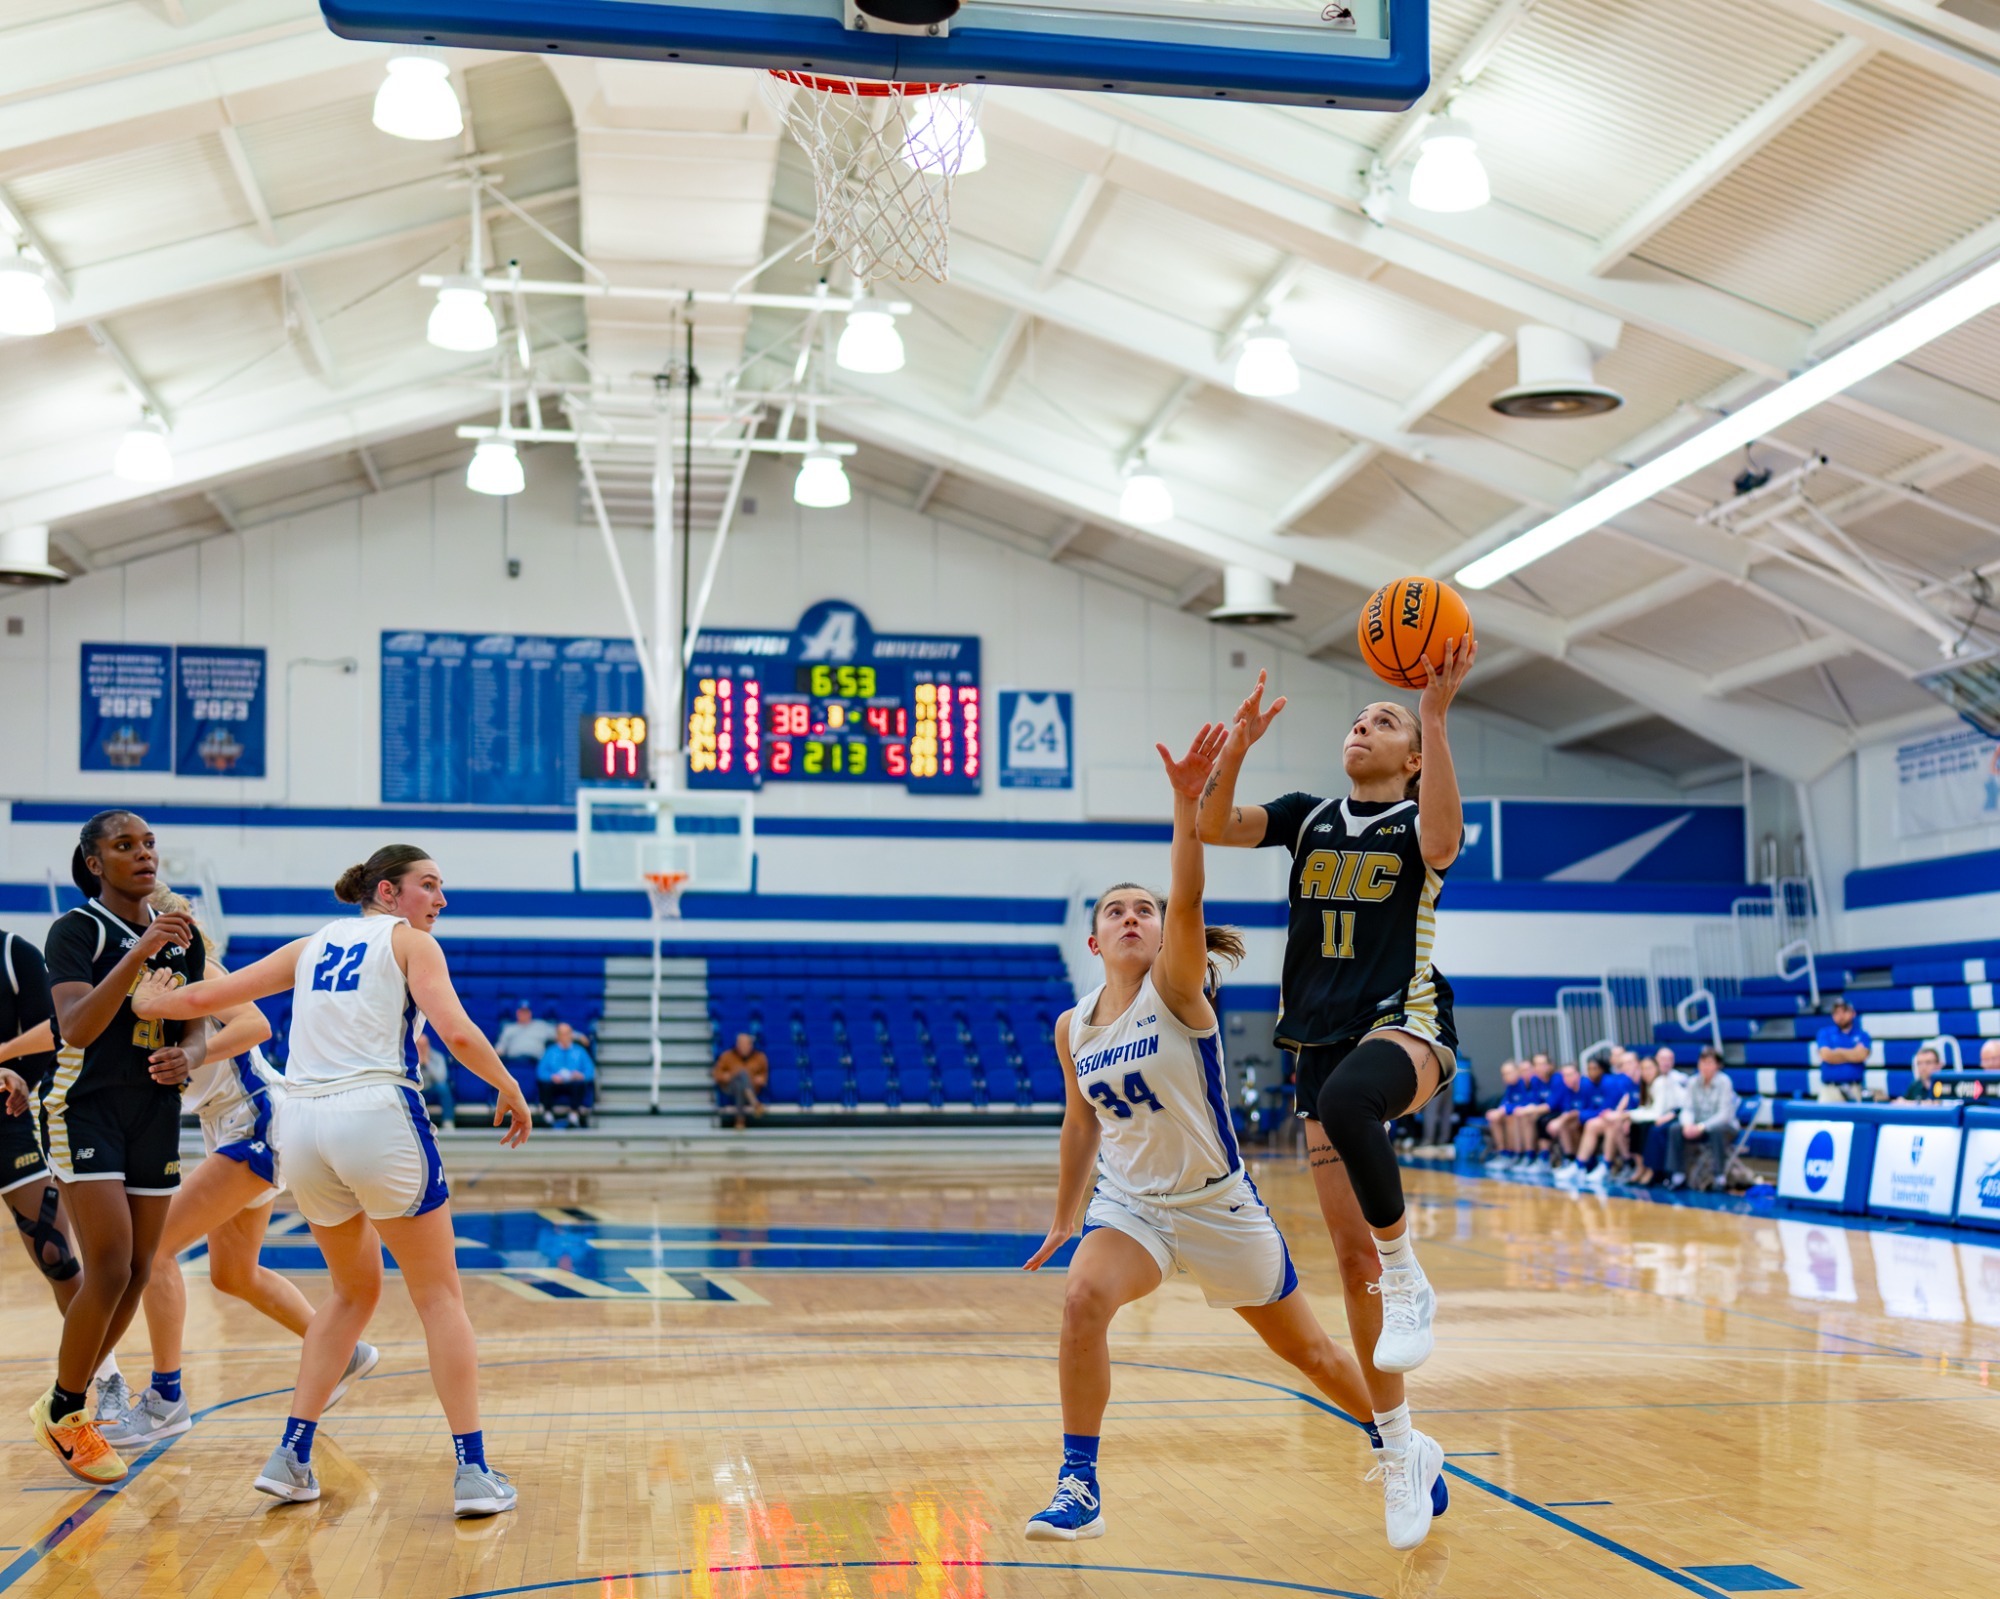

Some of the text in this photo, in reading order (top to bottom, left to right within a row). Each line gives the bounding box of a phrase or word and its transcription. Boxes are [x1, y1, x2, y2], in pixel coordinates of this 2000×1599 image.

[1401, 582, 1424, 629] NCAA
[873, 639, 961, 661] UNIVERSITY
[771, 703, 810, 737] 38
[867, 706, 907, 738] 41
[1016, 720, 1056, 753] 24
[604, 740, 637, 776] 17
[771, 741, 792, 774] 2
[885, 743, 907, 776] 5
[1300, 849, 1402, 902] AIC
[1322, 910, 1356, 959] 11
[311, 942, 368, 992] 22
[1088, 1069, 1165, 1119] 34
[14, 1151, 40, 1169] AIC
[1891, 1171, 1935, 1188] Assumption
